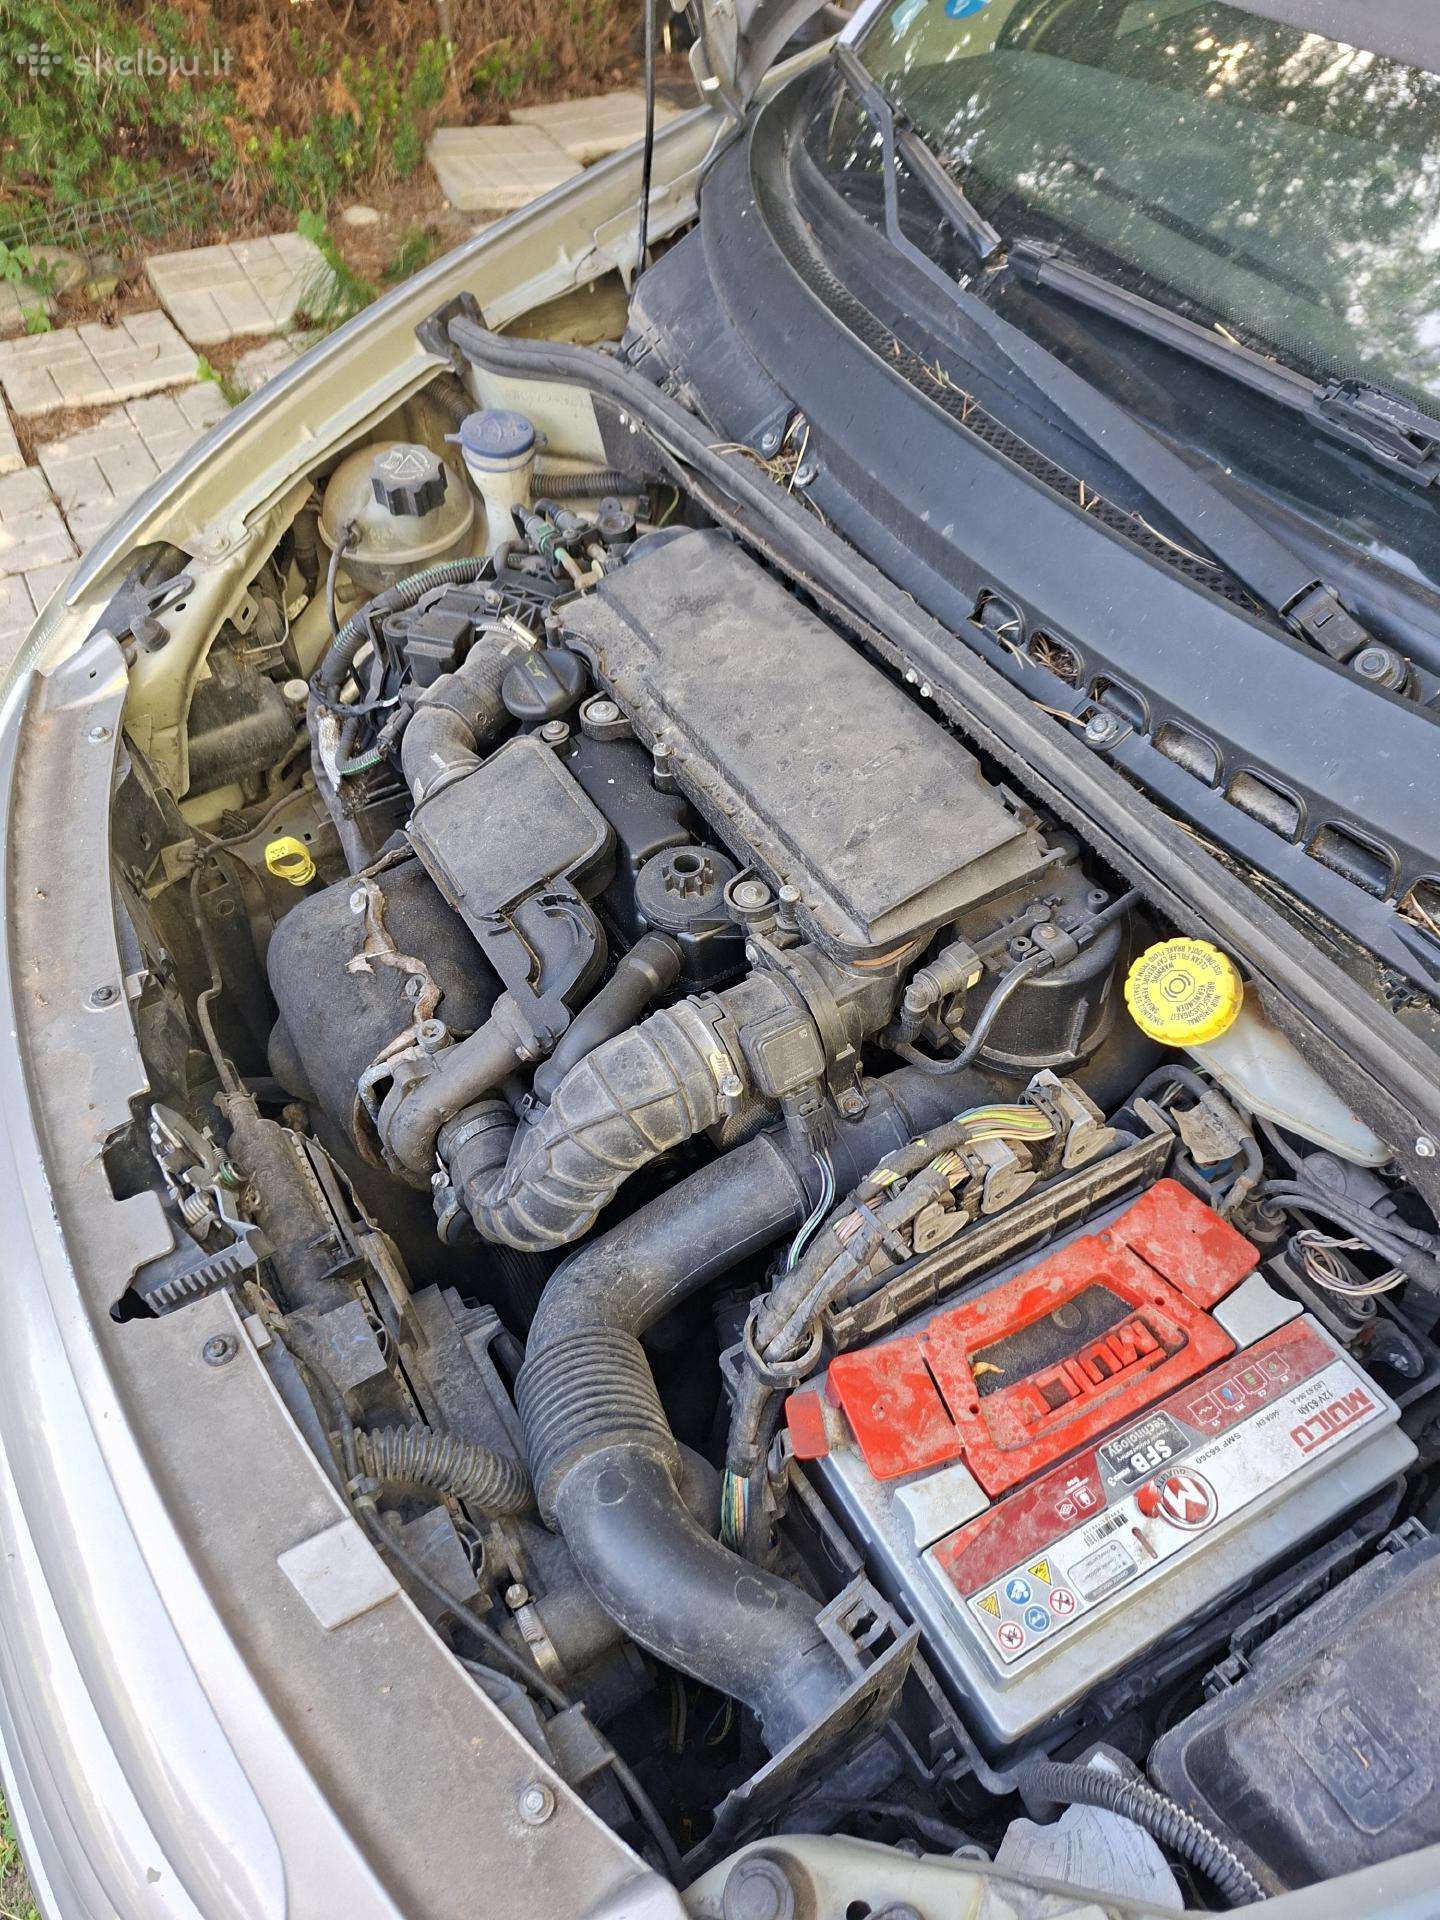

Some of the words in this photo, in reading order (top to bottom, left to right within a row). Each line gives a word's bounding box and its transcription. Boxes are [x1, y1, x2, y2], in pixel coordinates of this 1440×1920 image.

[1165, 945, 1186, 953] BRAKE
[1169, 953, 1190, 961] FILLER
[1157, 956, 1169, 966] CAP
[1192, 956, 1208, 970] CLEAN
[1142, 964, 1157, 986] BEFORE
[1150, 961, 1175, 984] WARNING
[1004, 1318, 1166, 1436] MUTLU
[1317, 1389, 1333, 1404] 12V
[1297, 1398, 1318, 1415] 63Ah
[1255, 1418, 1265, 1427] EN
[1289, 1387, 1375, 1453] MUTLU
[1107, 1416, 1166, 1457] technology
[1221, 1431, 1241, 1447] SMF
[1128, 1437, 1172, 1474] SFB
[1160, 1475, 1207, 1519] M
